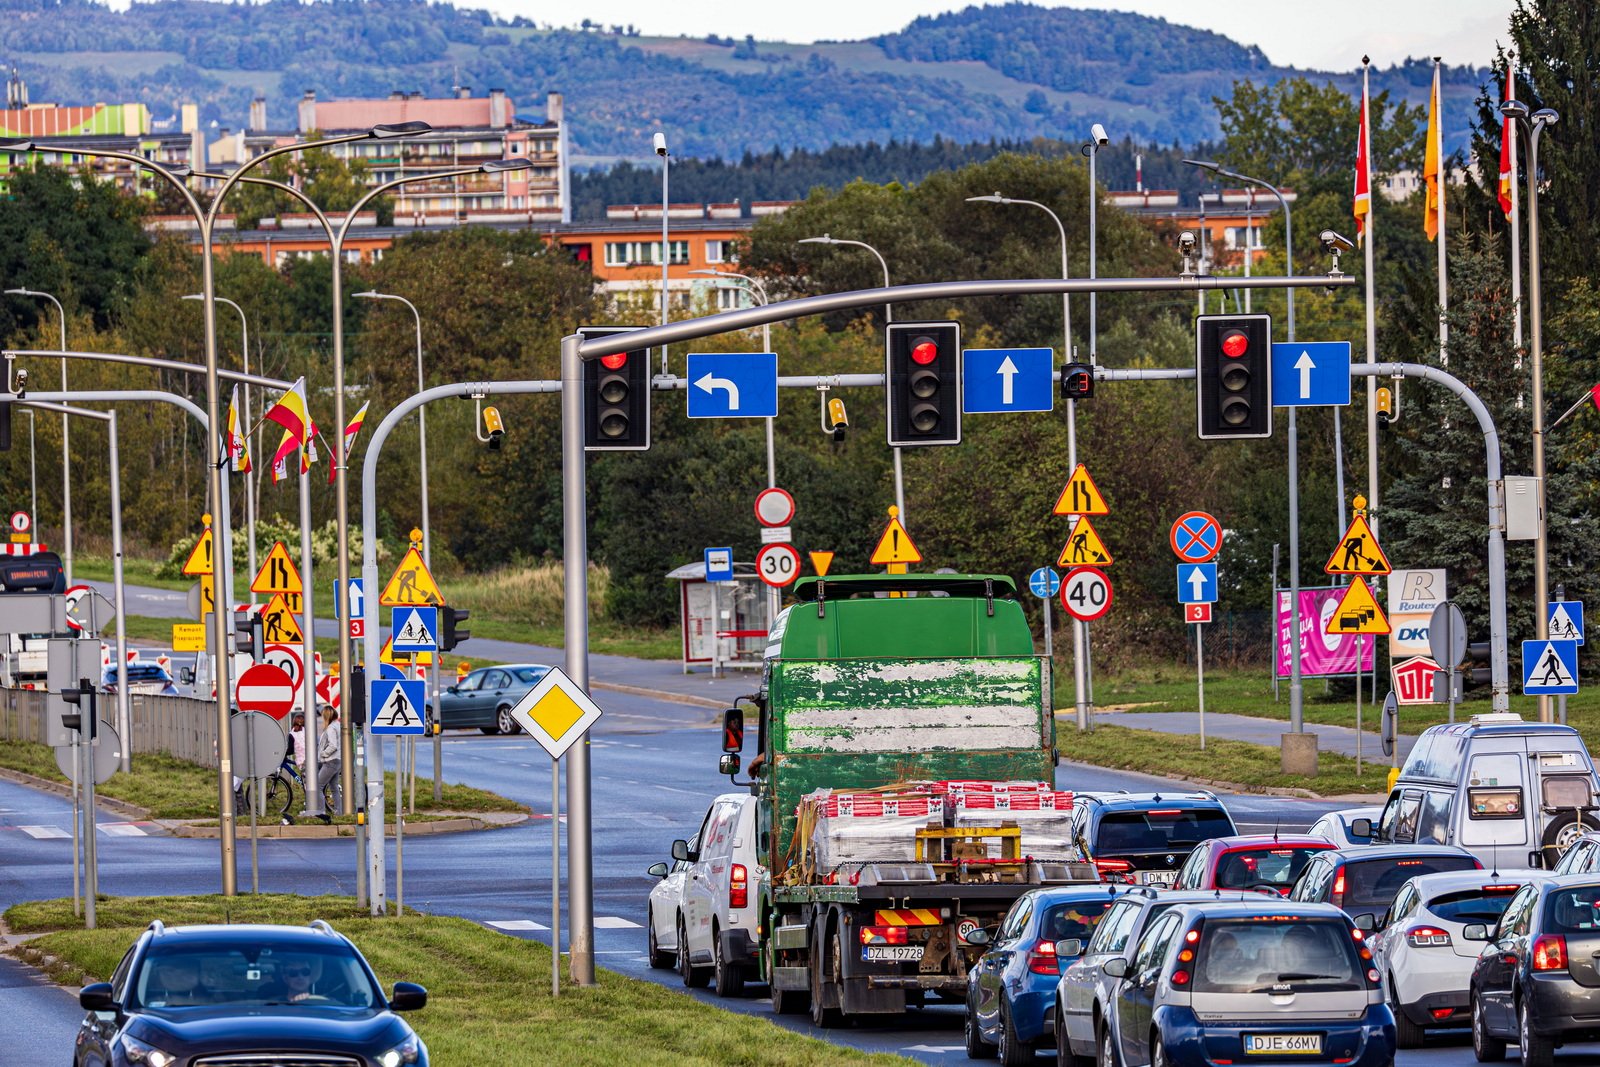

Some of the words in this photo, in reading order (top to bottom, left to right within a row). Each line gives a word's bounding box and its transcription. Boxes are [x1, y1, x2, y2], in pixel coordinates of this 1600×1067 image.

[765, 555, 792, 574] 30
[1401, 571, 1436, 600] R
[1069, 581, 1106, 607] 40
[1194, 606, 1203, 619] 3
[1399, 602, 1436, 611] Routex
[351, 622, 360, 634] 3
[961, 924, 974, 935] 80
[868, 948, 888, 959] DZL
[892, 948, 922, 959] 19728
[1272, 983, 1291, 991] smart
[1254, 1036, 1283, 1050] DJE
[1286, 1036, 1318, 1050] 66MV
